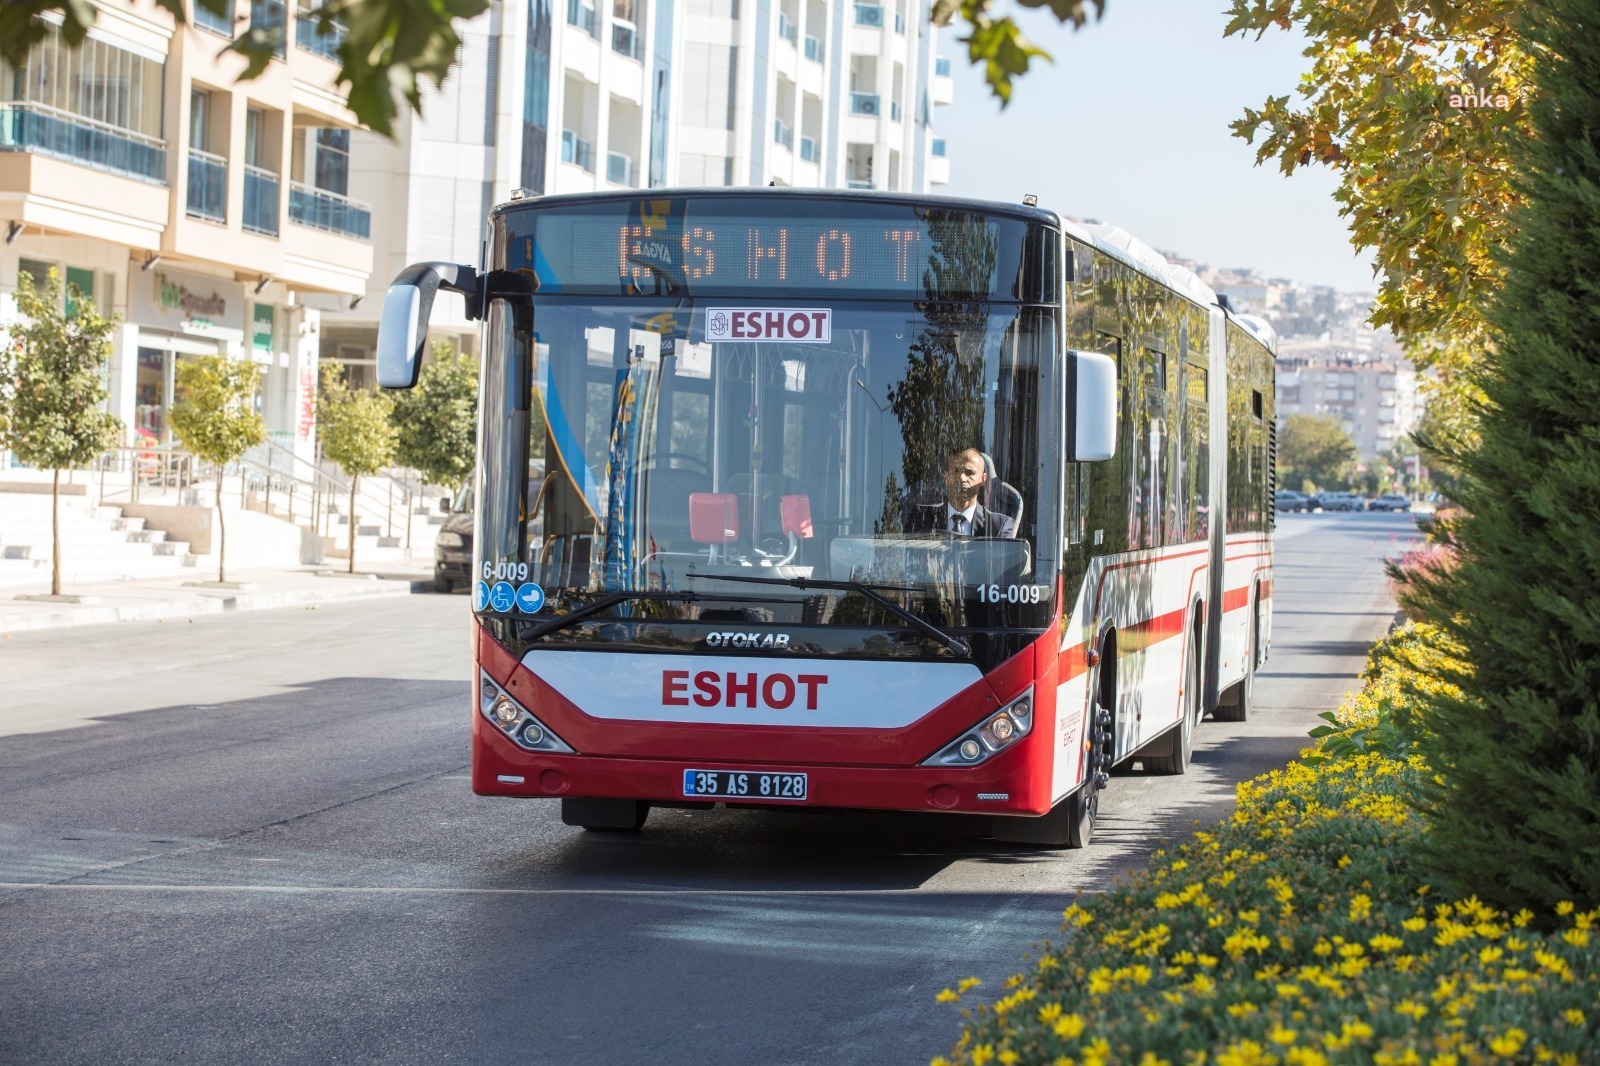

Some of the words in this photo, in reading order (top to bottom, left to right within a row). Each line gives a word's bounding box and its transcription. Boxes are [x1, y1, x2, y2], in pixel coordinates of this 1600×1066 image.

[620, 226, 920, 281] ESHOT
[731, 312, 827, 339] ESHOT
[977, 583, 1040, 604] 16-009
[706, 631, 790, 649] OTOKAR
[662, 670, 829, 710] ESHOT
[696, 772, 718, 794] 35
[726, 773, 749, 795] AS
[760, 775, 804, 797] 8128
